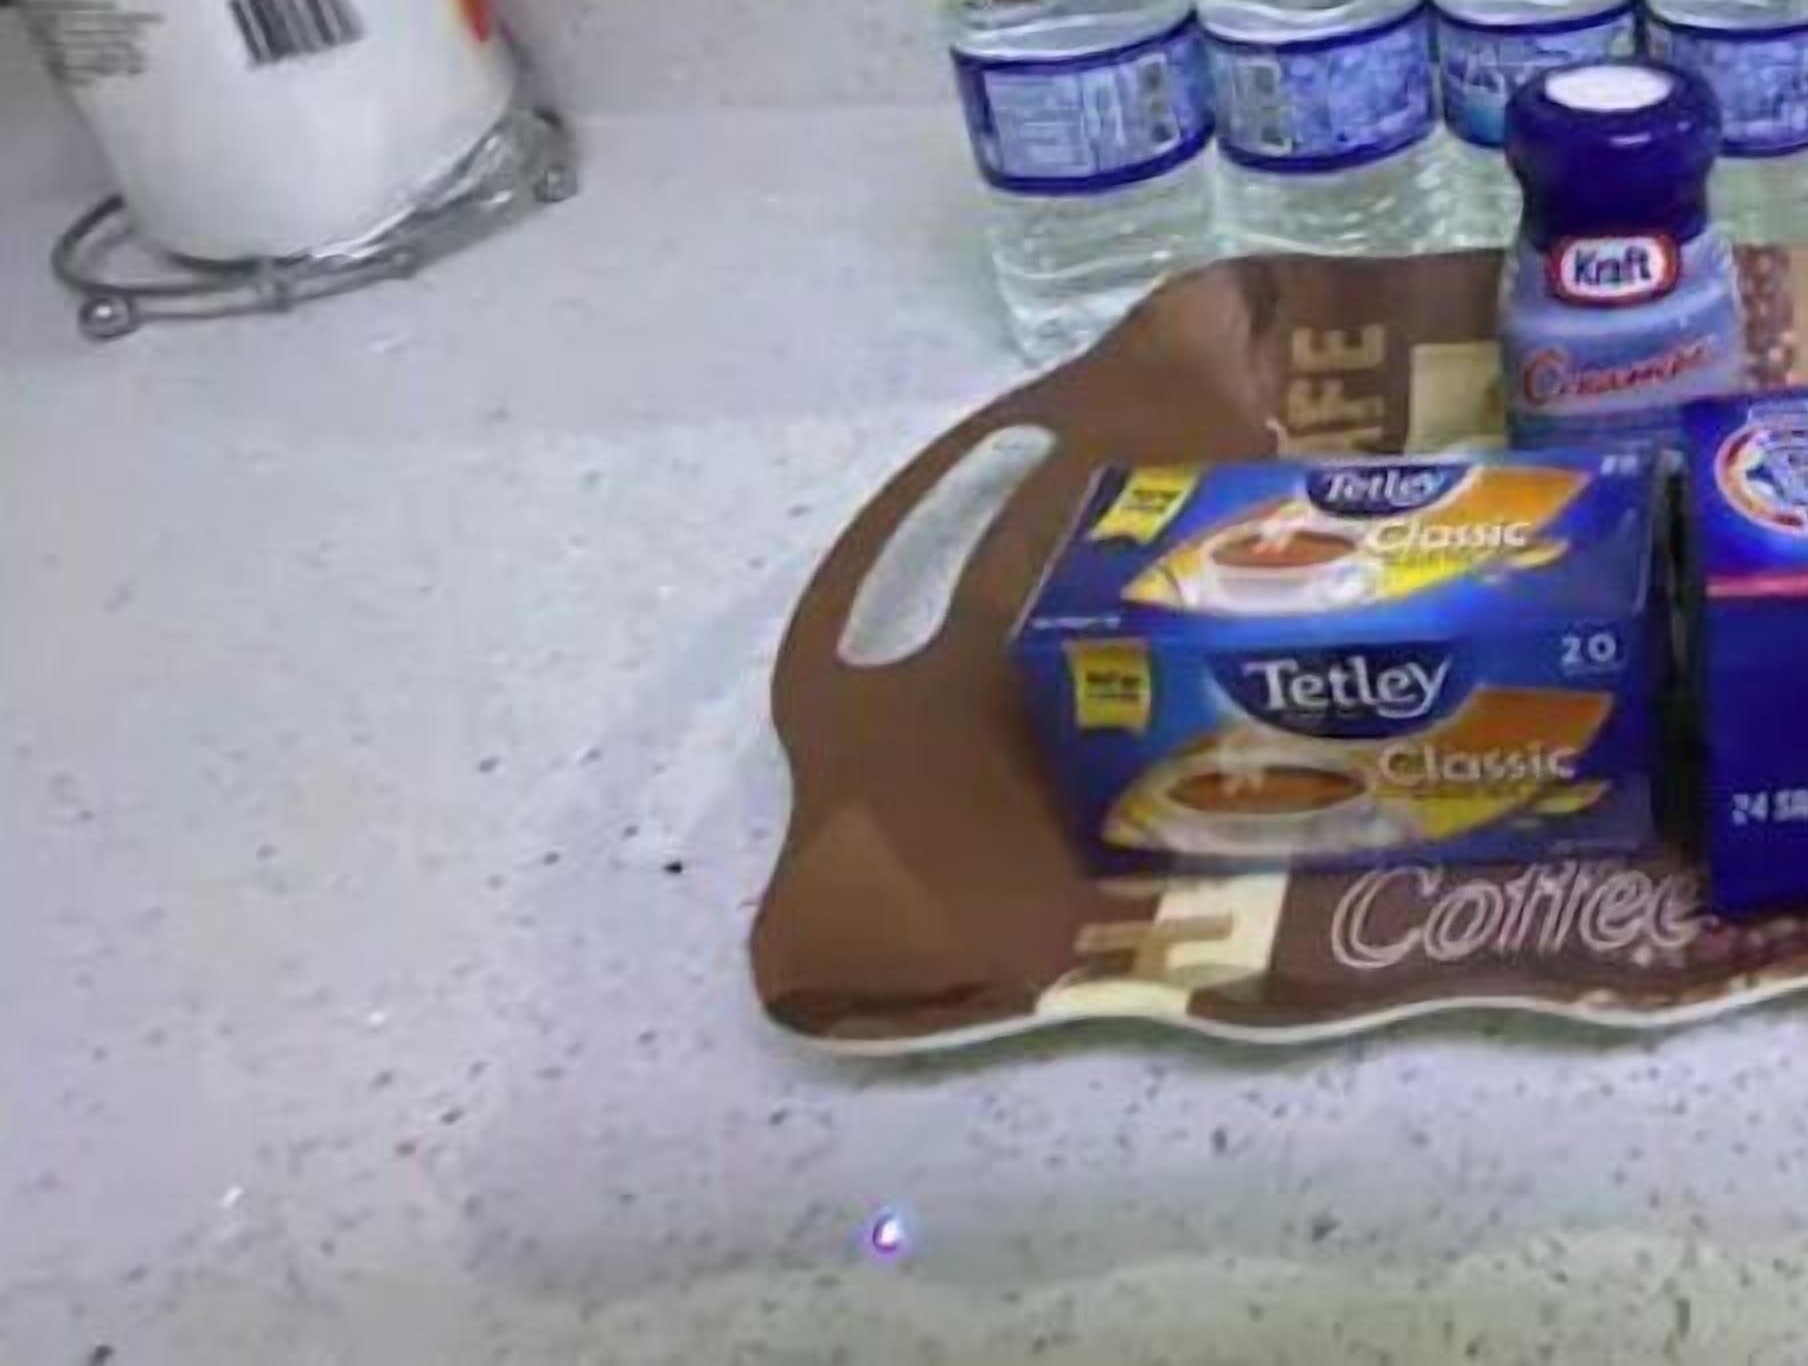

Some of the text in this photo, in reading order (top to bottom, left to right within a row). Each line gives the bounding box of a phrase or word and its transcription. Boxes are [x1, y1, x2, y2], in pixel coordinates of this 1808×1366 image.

[1573, 244, 1653, 287] Kraft
[1324, 470, 1448, 509] Tetley
[1365, 520, 1534, 560] Classic
[1560, 633, 1619, 665] 20
[1242, 652, 1455, 719] Tetley
[1378, 742, 1578, 789] Classic
